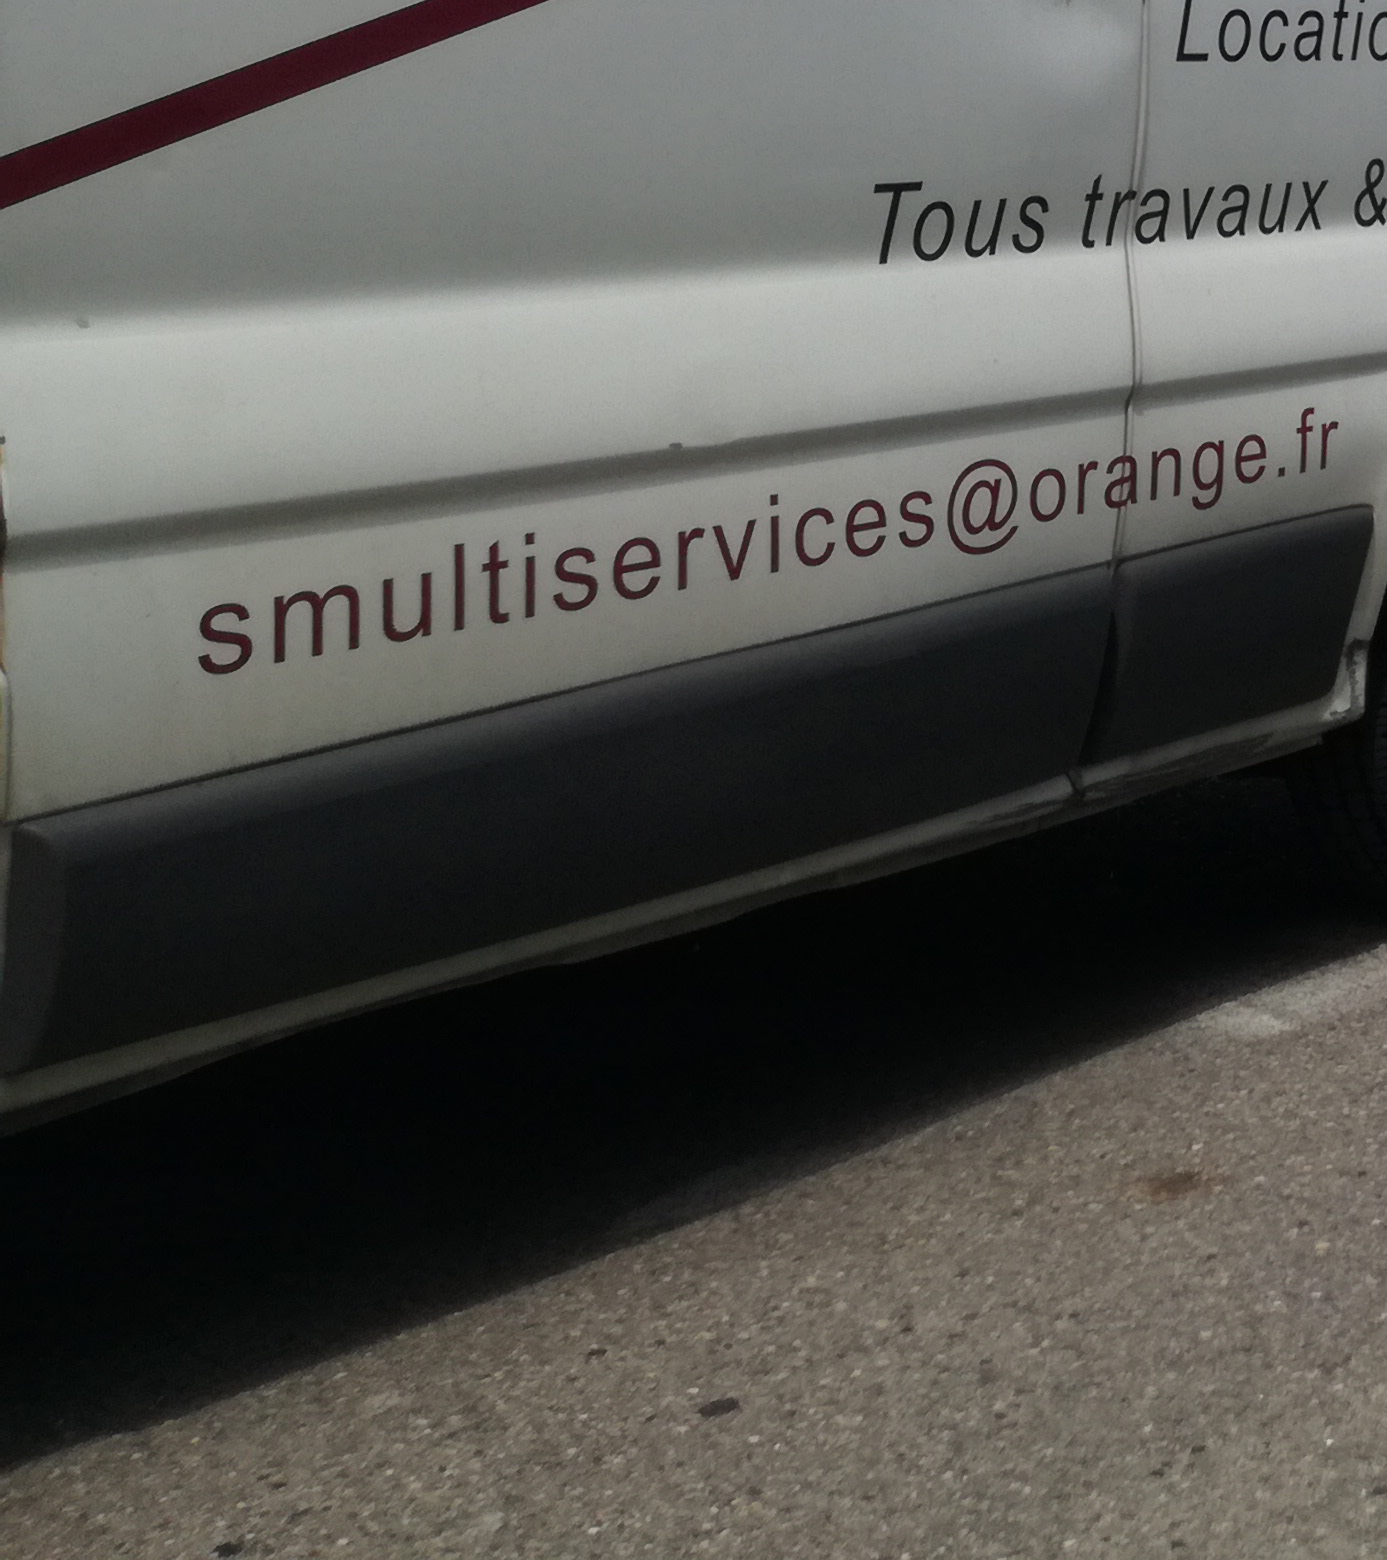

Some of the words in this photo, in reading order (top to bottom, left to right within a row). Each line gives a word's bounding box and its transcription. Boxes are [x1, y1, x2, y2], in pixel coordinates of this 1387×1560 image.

[872, 180, 1050, 266] Tous
[1080, 174, 1329, 249] travaux
[1353, 158, 1387, 228] &
[197, 408, 1340, 675] smultiservices@orange.fr
